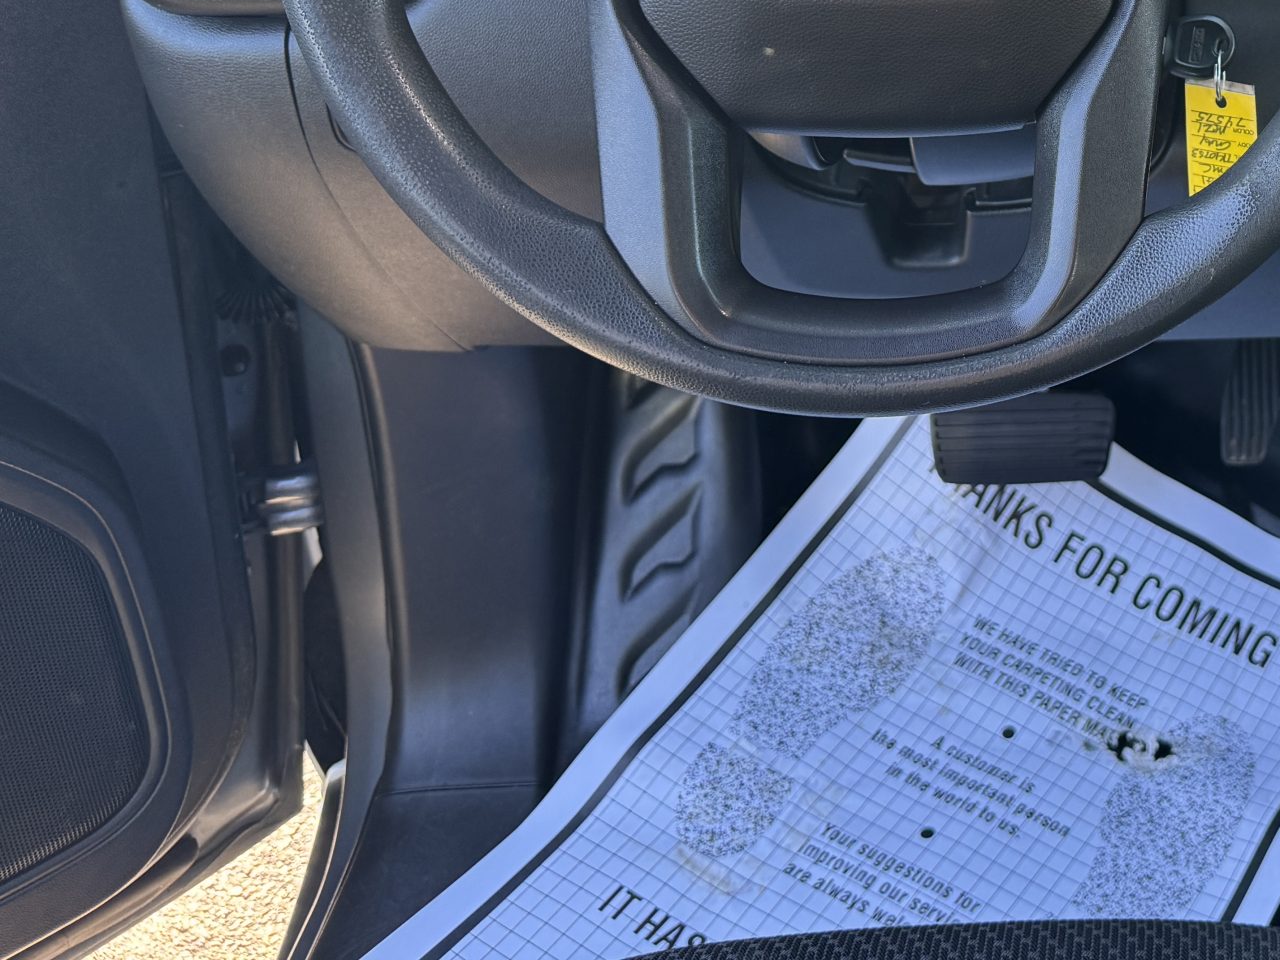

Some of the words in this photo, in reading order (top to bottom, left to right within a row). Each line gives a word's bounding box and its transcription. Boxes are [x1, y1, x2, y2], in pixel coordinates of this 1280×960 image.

[950, 480, 1053, 550] ANKS
[1054, 530, 1129, 594] FOR
[1132, 575, 1279, 669] COMING
[953, 651, 994, 678] WITH
[995, 671, 1028, 699] THIS
[1030, 690, 1080, 727] PAPER
[959, 632, 1000, 662] YOUR
[1001, 654, 1084, 702] CARPETING
[1086, 694, 1135, 729] CLEAN
[973, 614, 999, 636] WE
[998, 627, 1039, 657] HAVE
[1040, 647, 1084, 678] TRIED
[1086, 670, 1108, 689] TO
[1108, 679, 1149, 710] KEEP
[871, 728, 897, 751] the
[899, 745, 939, 771] most
[938, 759, 1013, 808] important
[1012, 801, 1071, 838] person
[885, 761, 900, 778] in
[905, 770, 931, 792] the
[932, 788, 978, 818] world
[978, 805, 997, 823] to
[999, 820, 1021, 840] us.
[931, 735, 945, 751] A
[946, 743, 1018, 787] customer
[1018, 777, 1036, 794] is
[598, 885, 644, 920] IT
[783, 861, 812, 884] are
[812, 876, 871, 914] always
[798, 838, 878, 890] improving
[878, 881, 908, 903] our
[819, 823, 857, 850] Your
[857, 841, 955, 899] suggestions
[954, 890, 982, 915] for
